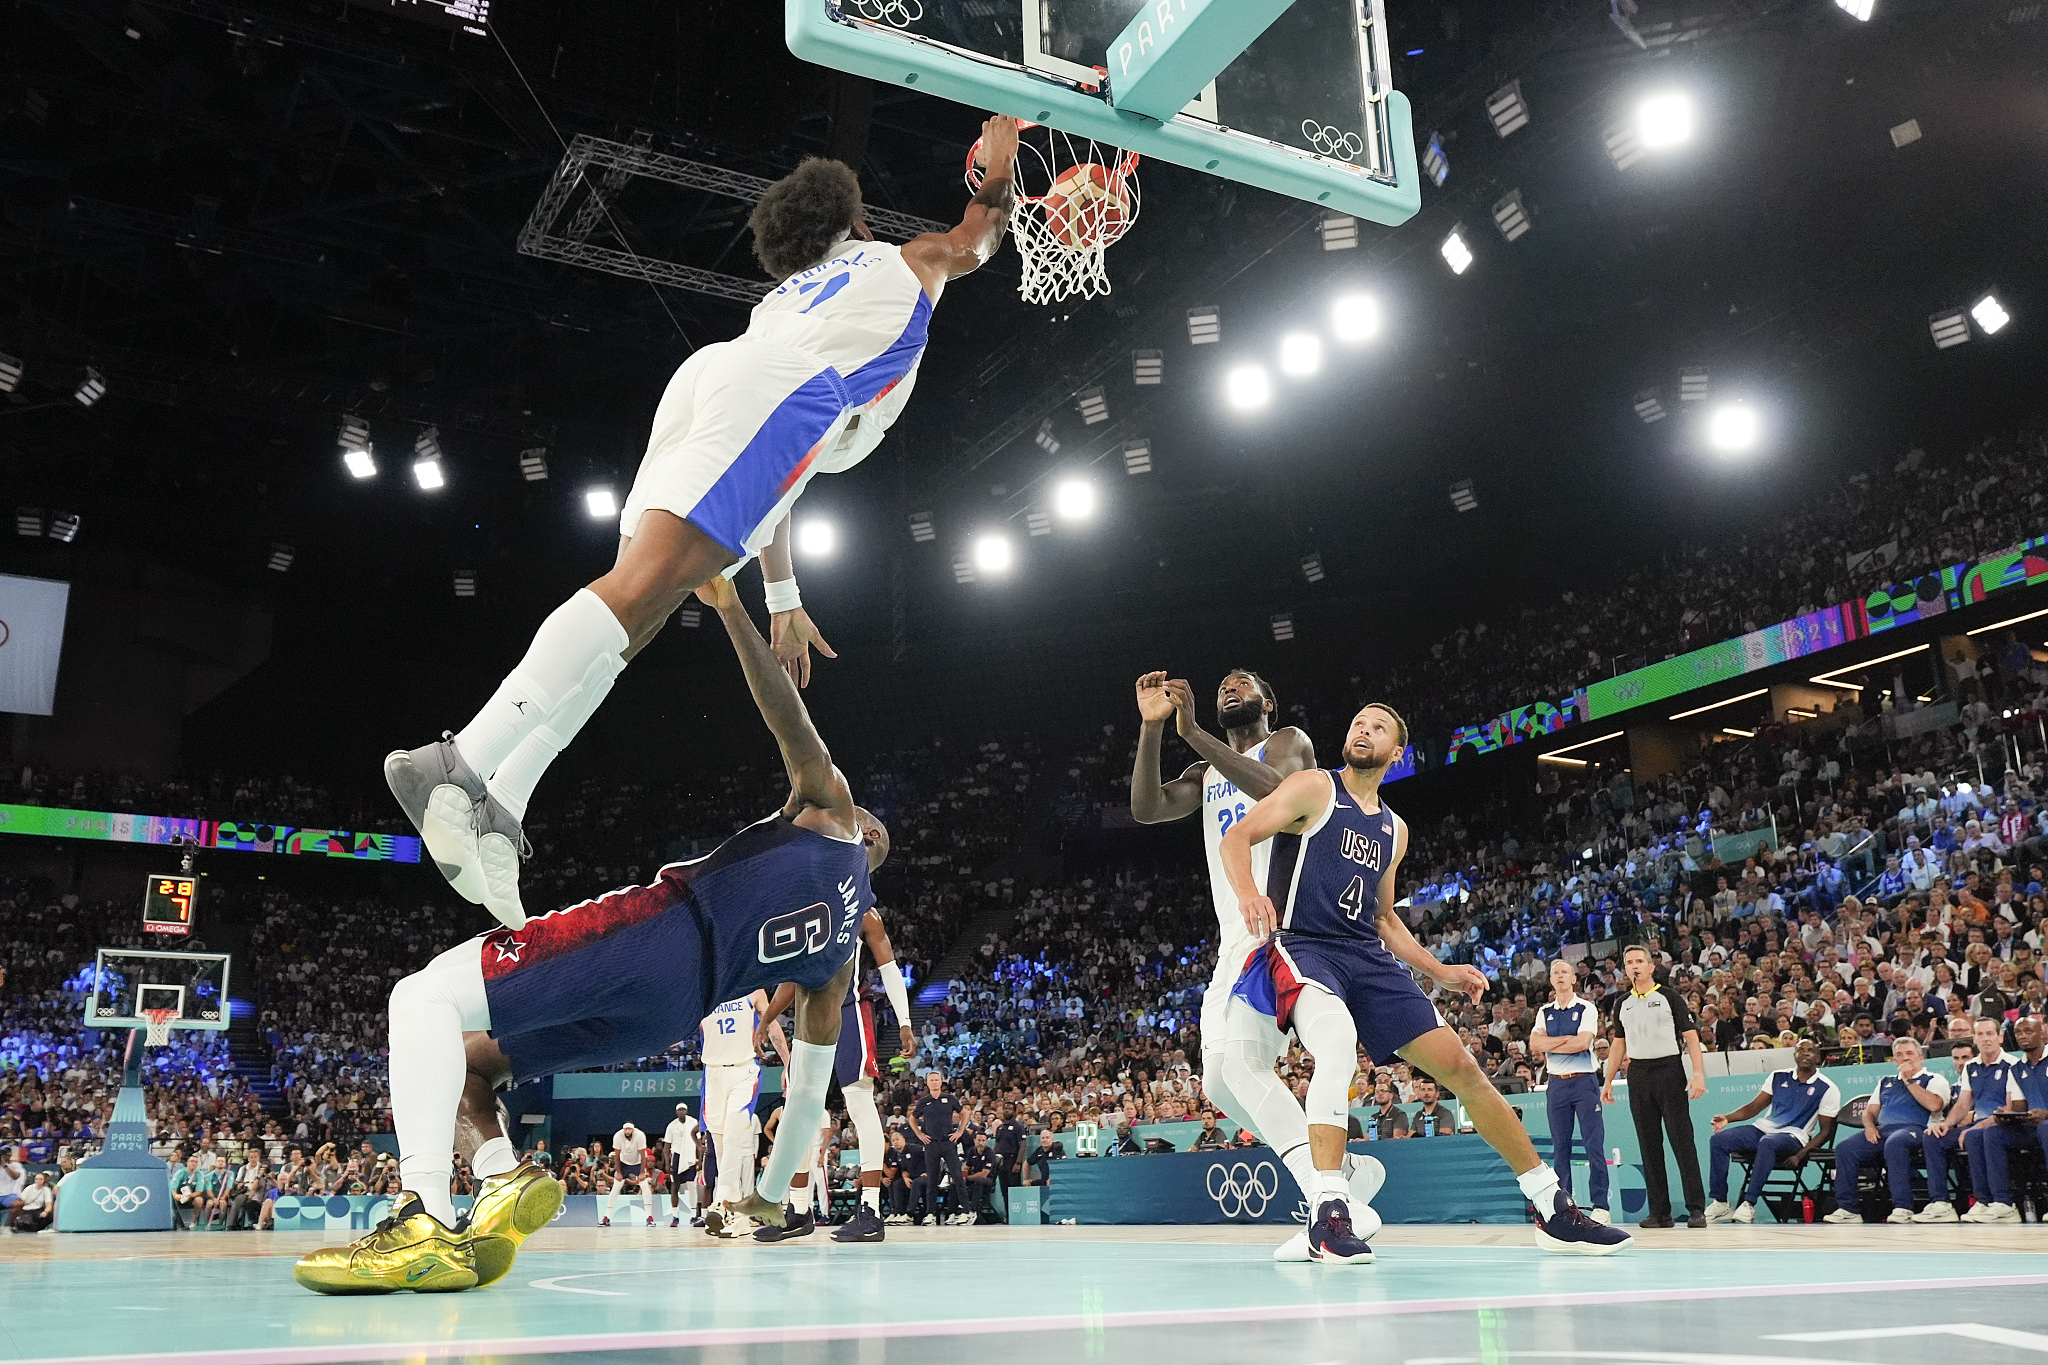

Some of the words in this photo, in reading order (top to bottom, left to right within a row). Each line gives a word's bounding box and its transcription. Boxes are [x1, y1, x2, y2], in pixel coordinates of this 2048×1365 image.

[1341, 828, 1381, 872] USA
[171, 897, 189, 921] 7
[837, 875, 860, 945] JAMES
[1338, 875, 1364, 921] 4
[155, 924, 187, 934] OMEGA
[758, 902, 832, 964] 6
[716, 1017, 736, 1035] 12
[111, 1133, 143, 1142] PARIS
[111, 1142, 143, 1151] 2024
[1077, 1123, 1098, 1152] 22
